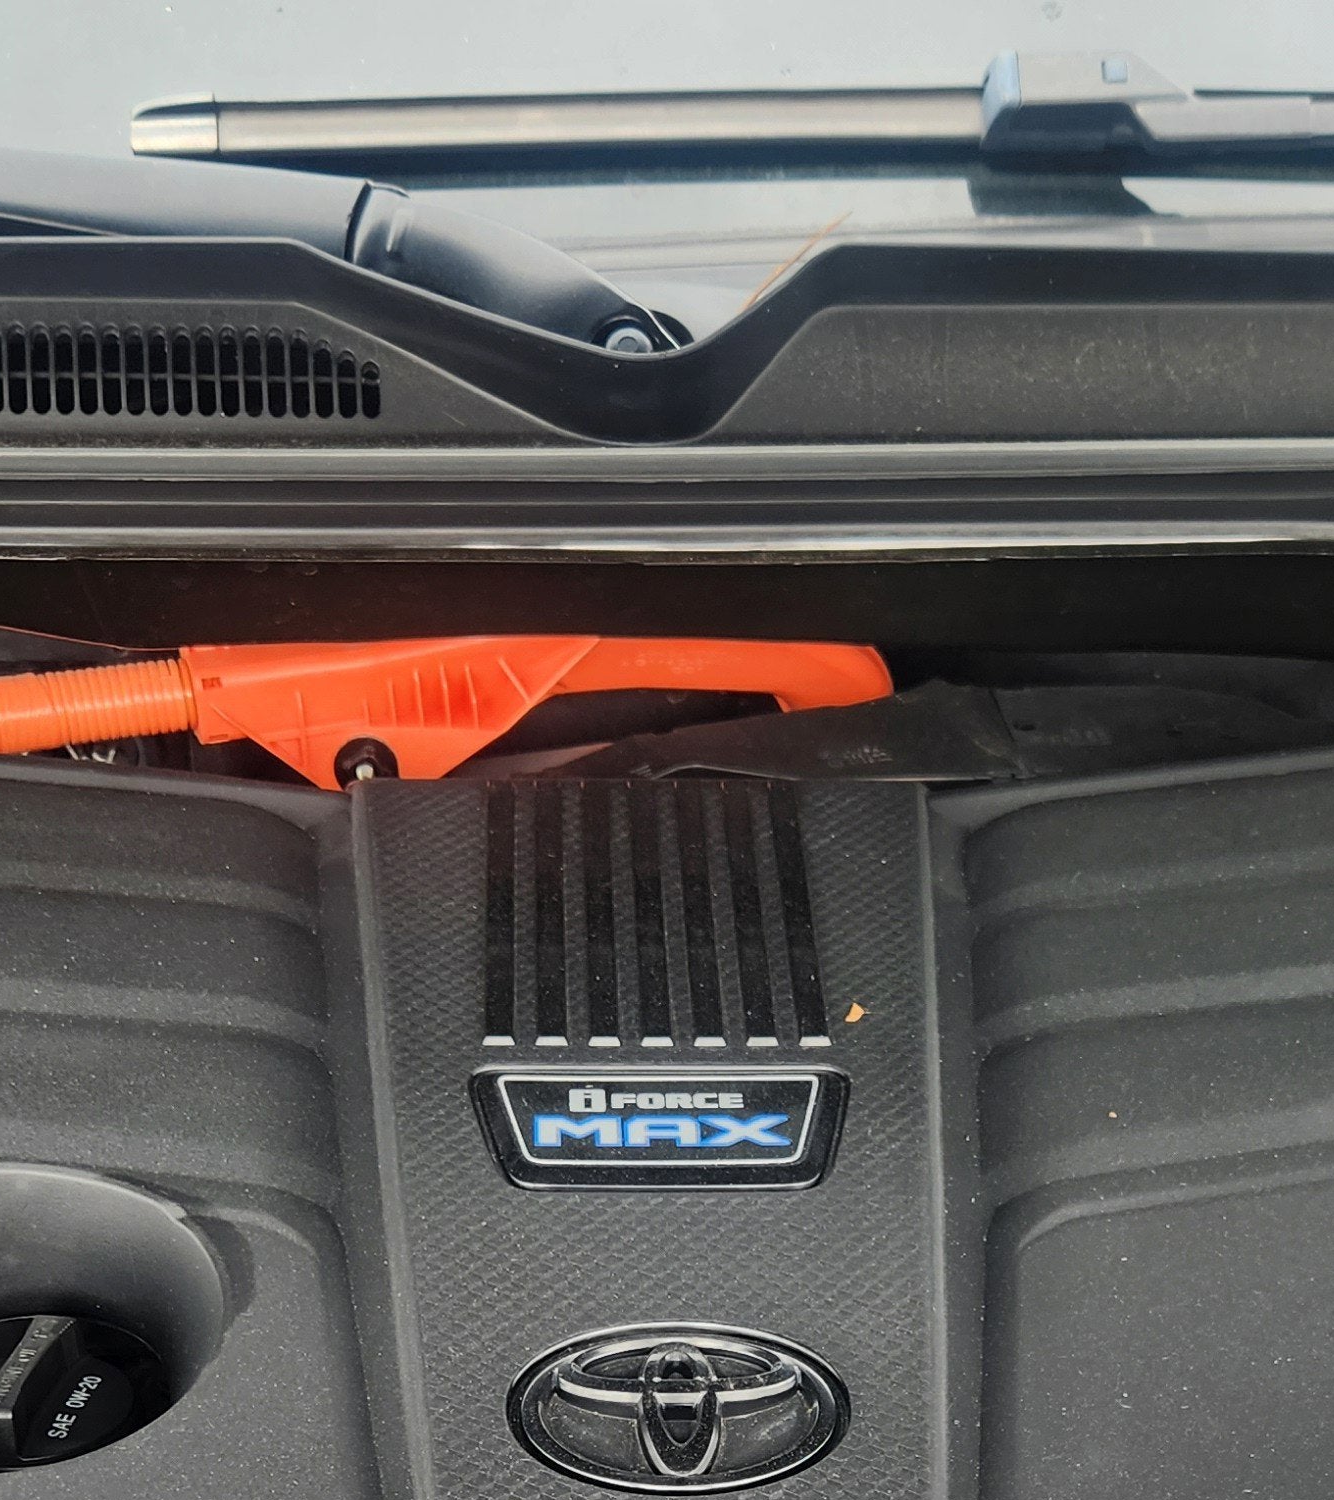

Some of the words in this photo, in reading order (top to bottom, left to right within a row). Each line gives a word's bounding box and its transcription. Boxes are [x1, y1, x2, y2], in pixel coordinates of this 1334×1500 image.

[611, 1092, 744, 1109] FORCE
[533, 1113, 792, 1147] MAX
[47, 1413, 77, 1439] SAE
[65, 1375, 103, 1408] 0W-20
